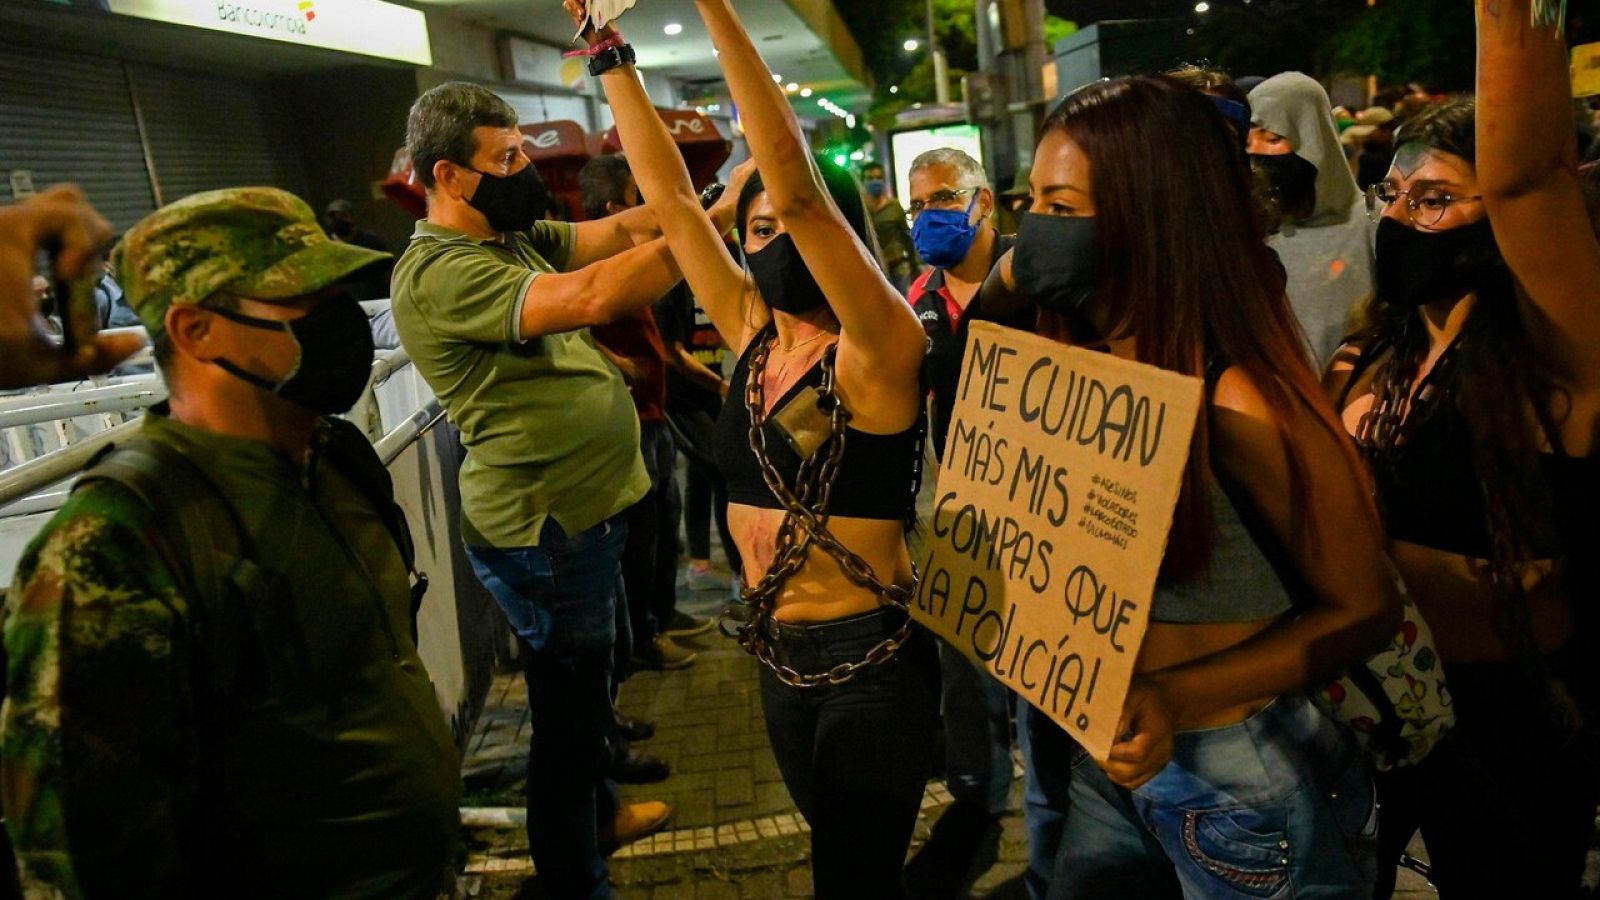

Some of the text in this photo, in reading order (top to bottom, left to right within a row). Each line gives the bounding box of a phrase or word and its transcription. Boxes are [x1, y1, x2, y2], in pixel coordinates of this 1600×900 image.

[948, 419, 1069, 527] MÁS MIS
[962, 338, 1166, 468] ME CUIDAN
[918, 550, 1102, 731] LA POLICÍA!
[934, 491, 1137, 654] COMPAS QUE
